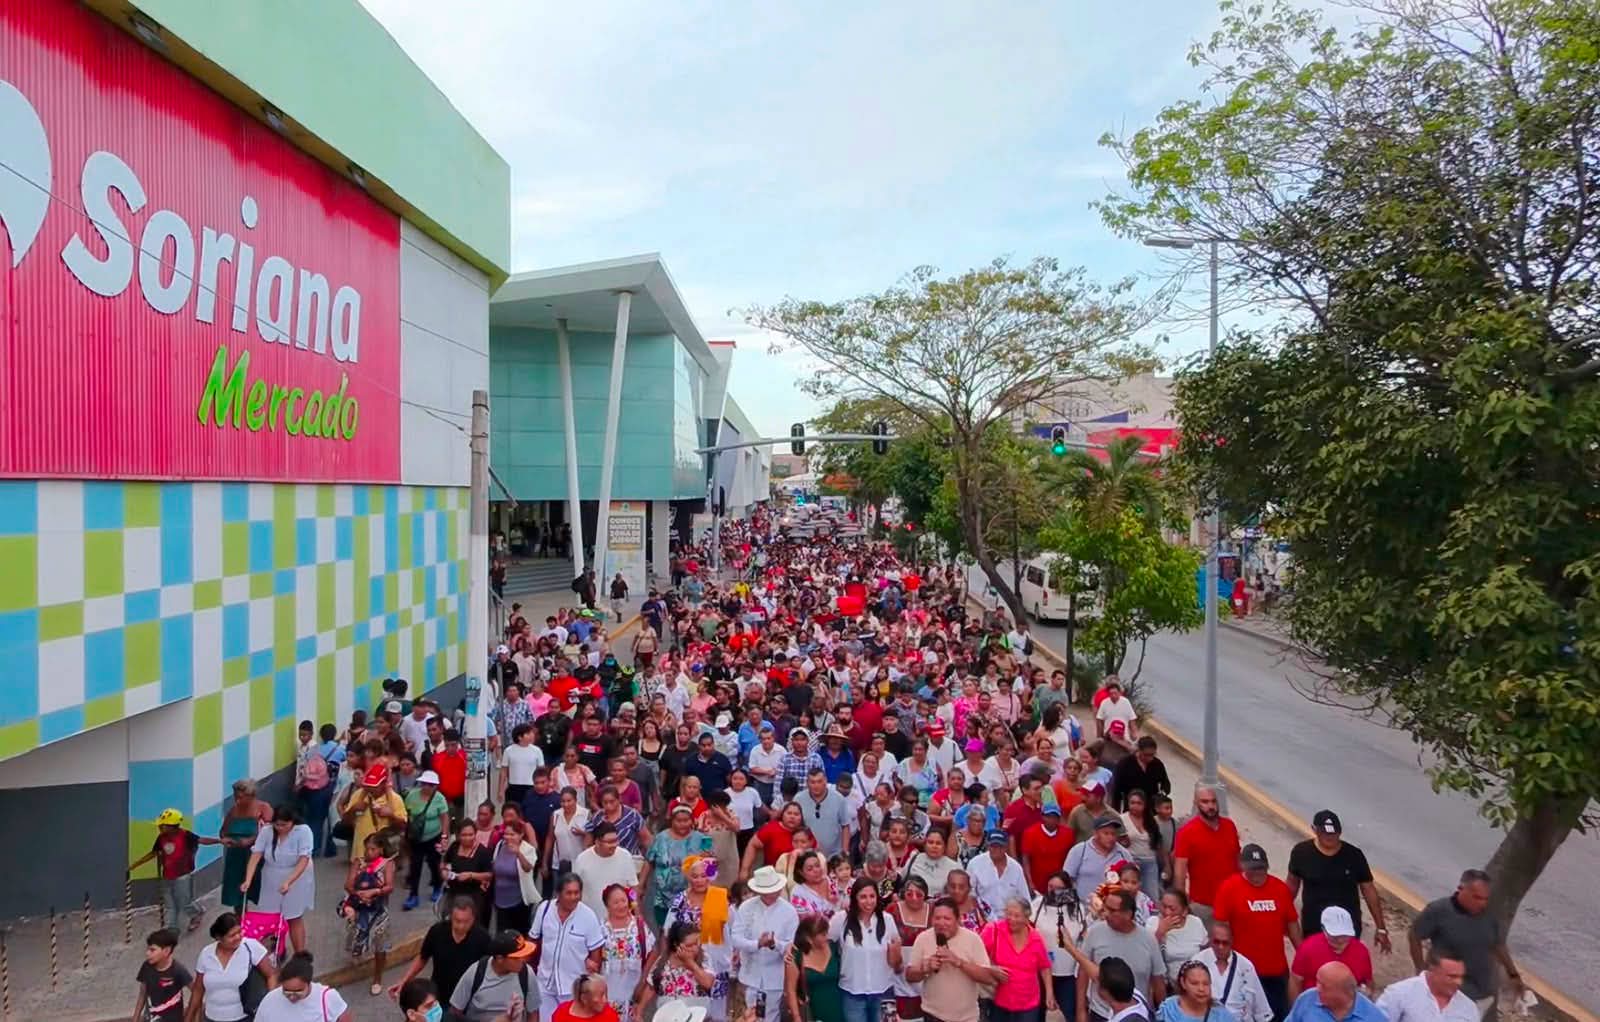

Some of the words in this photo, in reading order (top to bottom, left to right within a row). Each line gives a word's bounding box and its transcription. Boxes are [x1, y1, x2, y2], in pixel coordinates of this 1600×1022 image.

[60, 150, 361, 363] Soriana
[196, 344, 359, 441] Mercado
[1247, 899, 1277, 911] VANS
